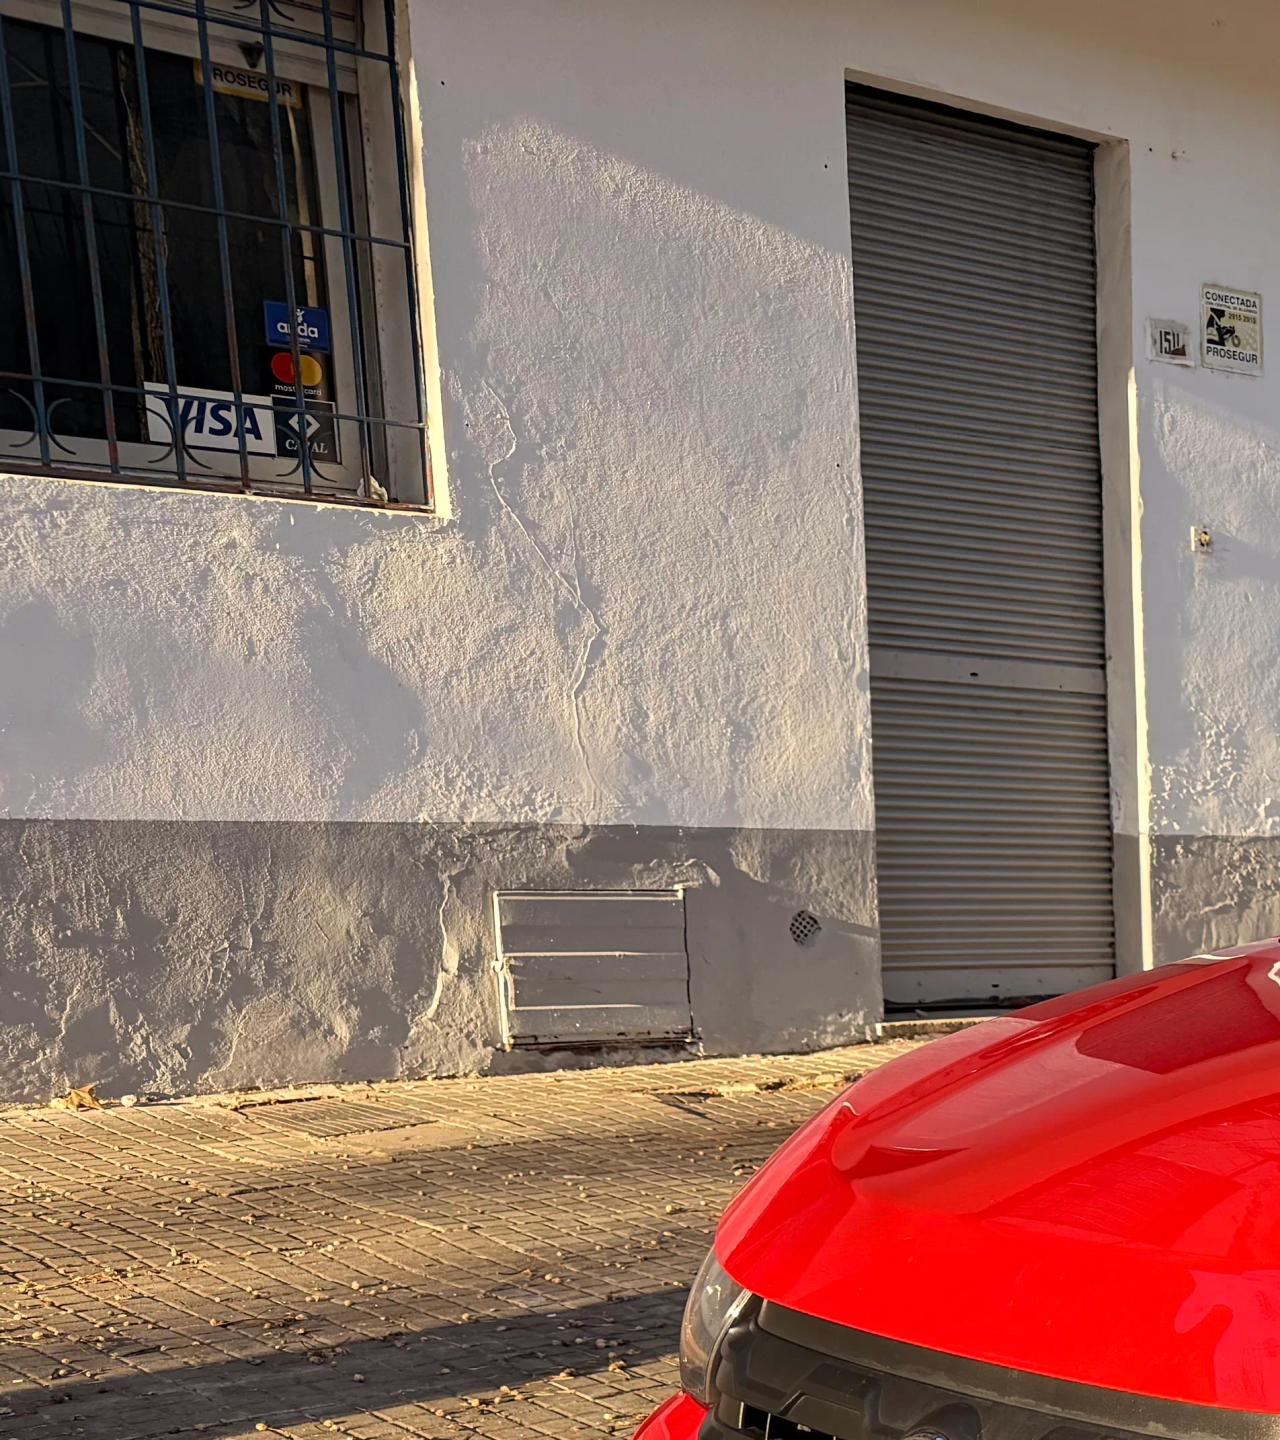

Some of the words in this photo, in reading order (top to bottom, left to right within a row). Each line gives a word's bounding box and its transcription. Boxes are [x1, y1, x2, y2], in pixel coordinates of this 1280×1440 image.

[1205, 291, 1258, 309] CONECTADA
[276, 322, 319, 338] ada
[1206, 346, 1259, 365] PROSEGUR
[274, 384, 322, 396] mastcard
[153, 394, 263, 441] VISA
